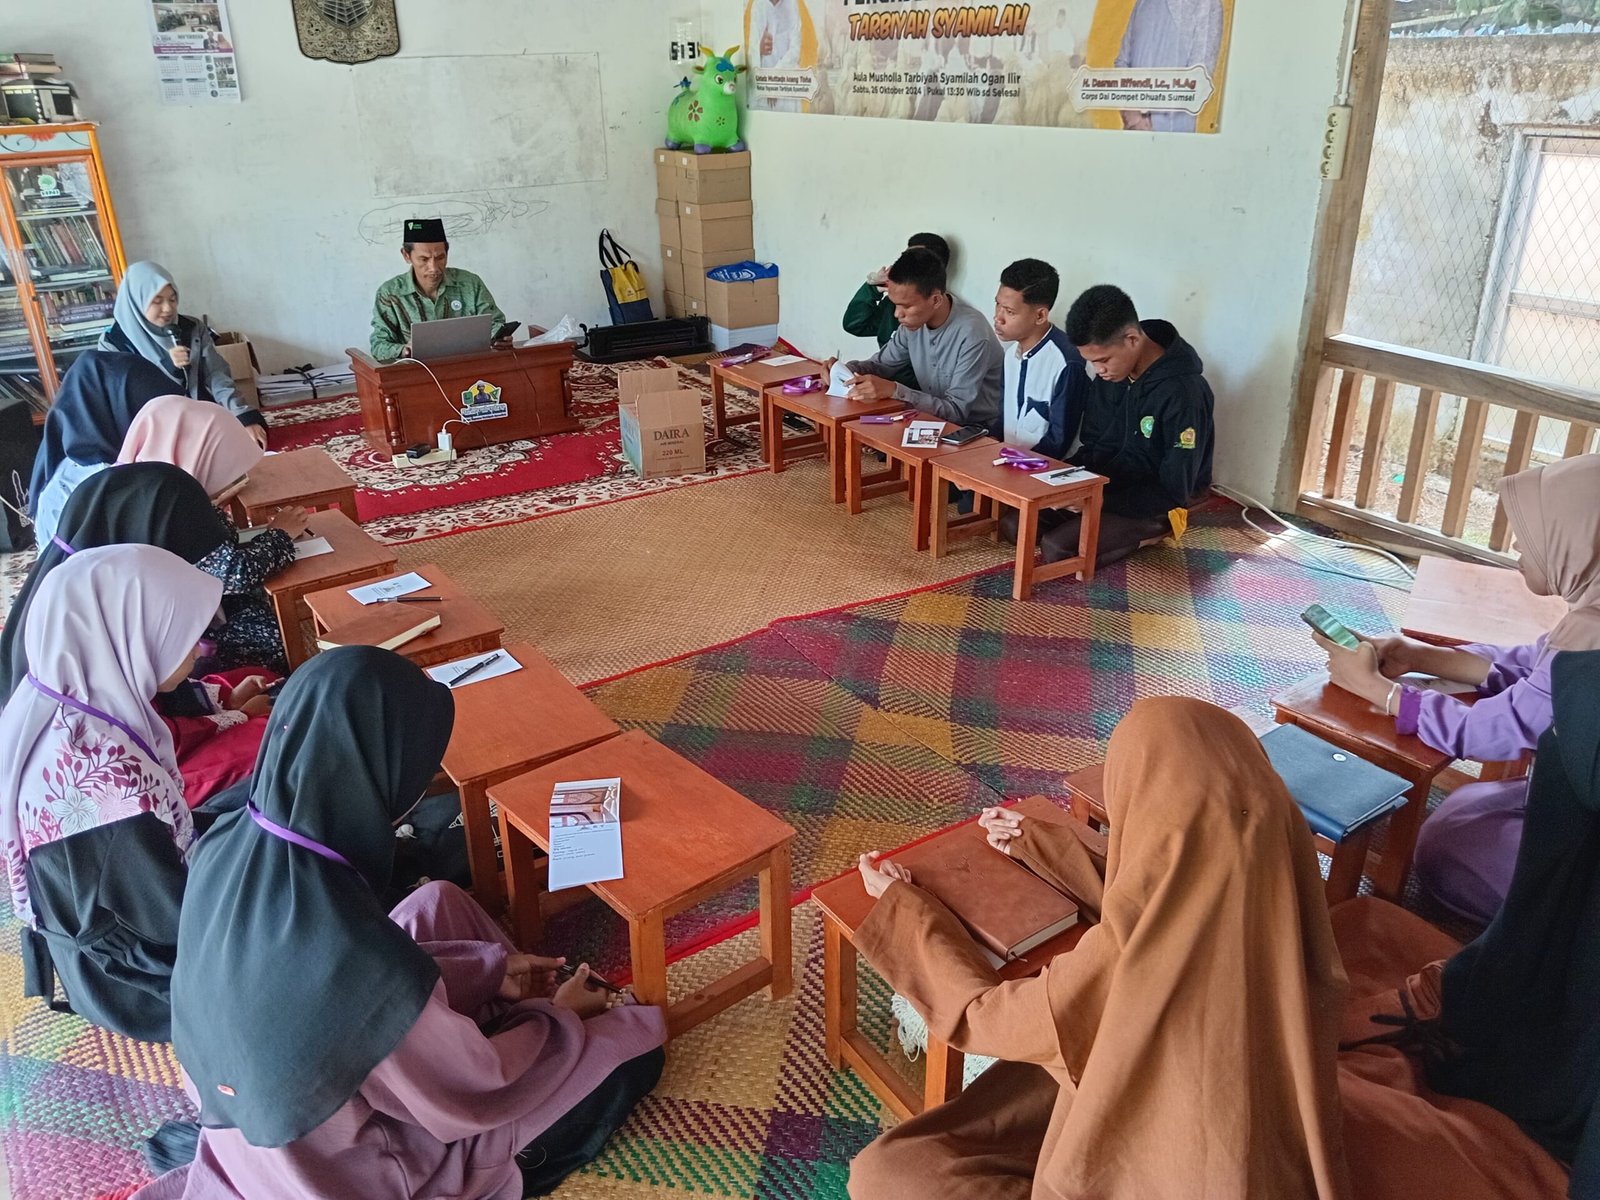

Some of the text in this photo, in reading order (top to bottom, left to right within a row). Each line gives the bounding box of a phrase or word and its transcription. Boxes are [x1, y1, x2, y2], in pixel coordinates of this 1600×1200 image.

[849, 3, 1031, 41] TARBIYAH SYAMILAH
[853, 72, 1021, 87] Aula Musholla Tarbiyah Syamilah Ogan Ilir
[879, 86, 904, 95] Oktober
[905, 87, 922, 96] 2024
[927, 88, 946, 96] Pukul
[947, 88, 965, 97] 13:30
[982, 88, 991, 97] sd
[992, 88, 1021, 98] Selesai
[1081, 93, 1098, 101] Corps
[1111, 93, 1139, 102] Dompet
[1140, 93, 1166, 102] Dhuafa
[1168, 93, 1196, 102] Sumsel
[654, 428, 690, 441] DAIRA
